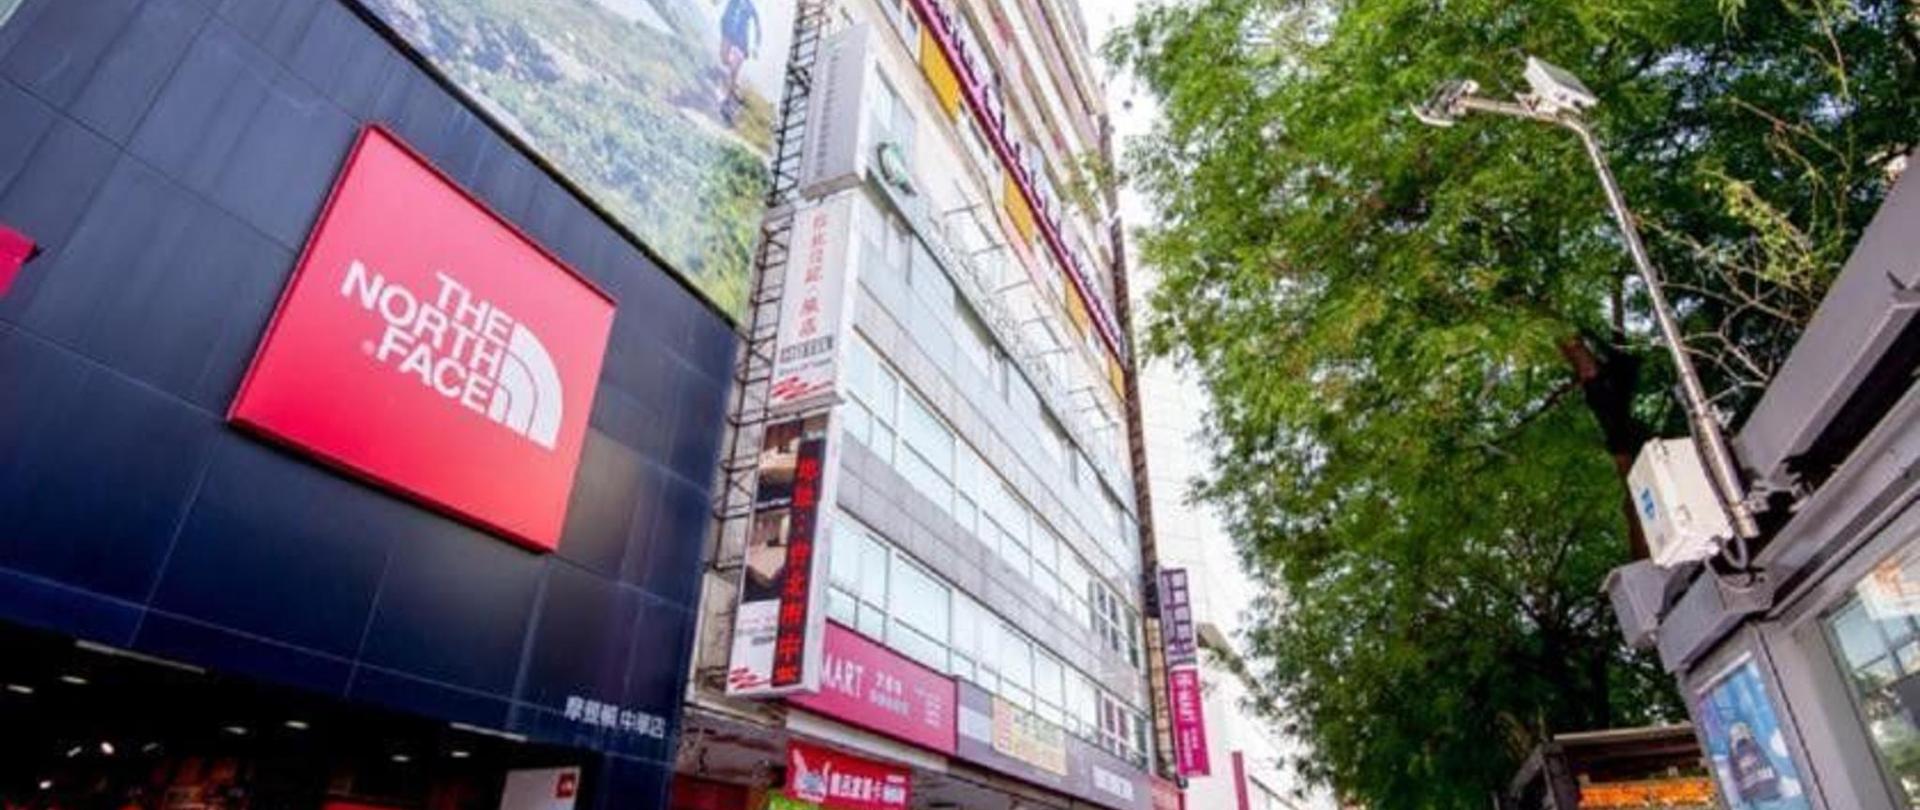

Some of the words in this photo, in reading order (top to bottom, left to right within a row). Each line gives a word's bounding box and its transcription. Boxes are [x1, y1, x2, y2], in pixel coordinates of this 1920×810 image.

[341, 258, 502, 380] NORTH
[436, 270, 514, 347] THE
[376, 325, 494, 415] FACE
